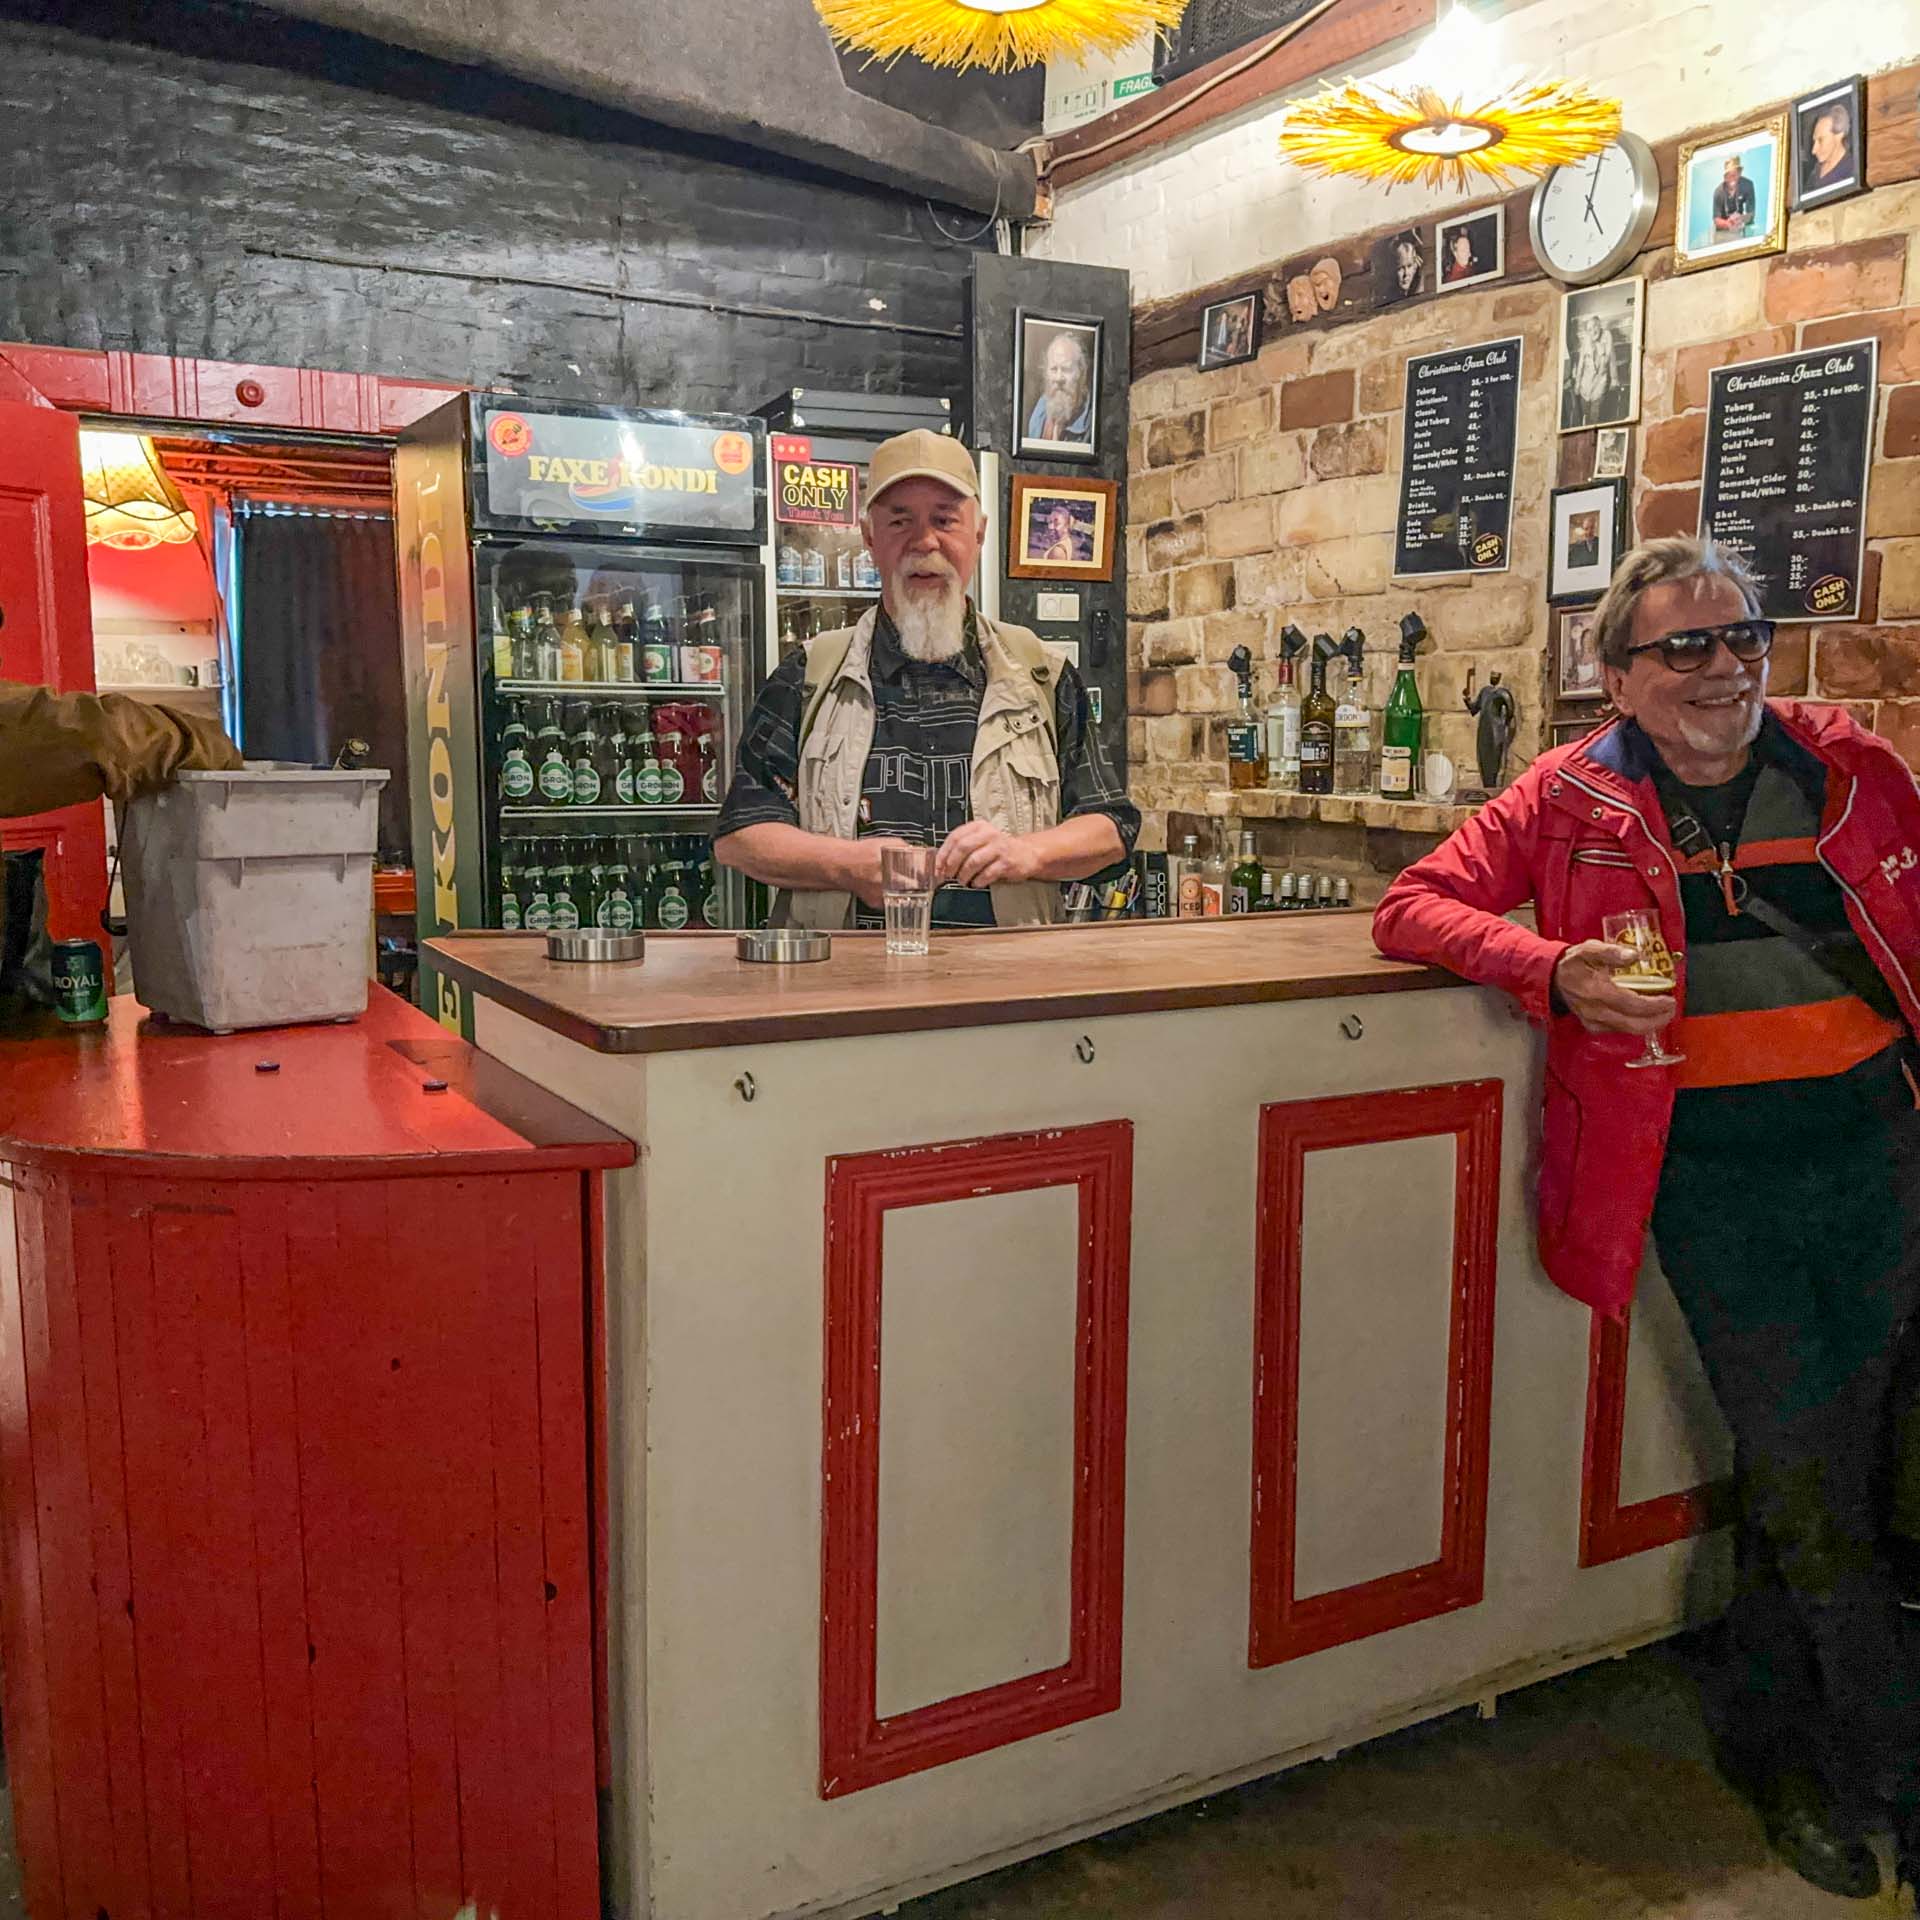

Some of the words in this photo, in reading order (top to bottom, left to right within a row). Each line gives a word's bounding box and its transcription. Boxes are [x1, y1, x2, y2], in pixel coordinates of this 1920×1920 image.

[1419, 362, 1461, 379] Christiania
[1462, 356, 1485, 372] Jazz
[1486, 350, 1507, 366] Club
[1727, 372, 1790, 393] Christiania
[1791, 364, 1823, 384] Jazz
[1825, 356, 1855, 375] Club
[1830, 387, 1842, 396] for
[1724, 411, 1772, 426] Christiania
[1723, 427, 1755, 439] Classic
[528, 455, 609, 486] FAXE
[783, 464, 848, 489] CASH
[1720, 467, 1735, 476] Ale
[1736, 466, 1745, 475] 16
[1719, 476, 1760, 489] Somersby
[1762, 474, 1787, 483] Cider
[783, 484, 849, 510] ONLY
[1718, 492, 1739, 501] Wine
[1741, 486, 1787, 499] Red/White
[1715, 510, 1738, 520] Shot
[1812, 501, 1839, 511] Double
[1811, 528, 1838, 537] Double
[1475, 537, 1499, 553] CASH
[1477, 547, 1499, 562] ONLY
[1813, 580, 1845, 599] CASH
[1815, 590, 1846, 609] ONLY
[1231, 895, 1244, 913] 51
[55, 974, 99, 989] ROYAL
